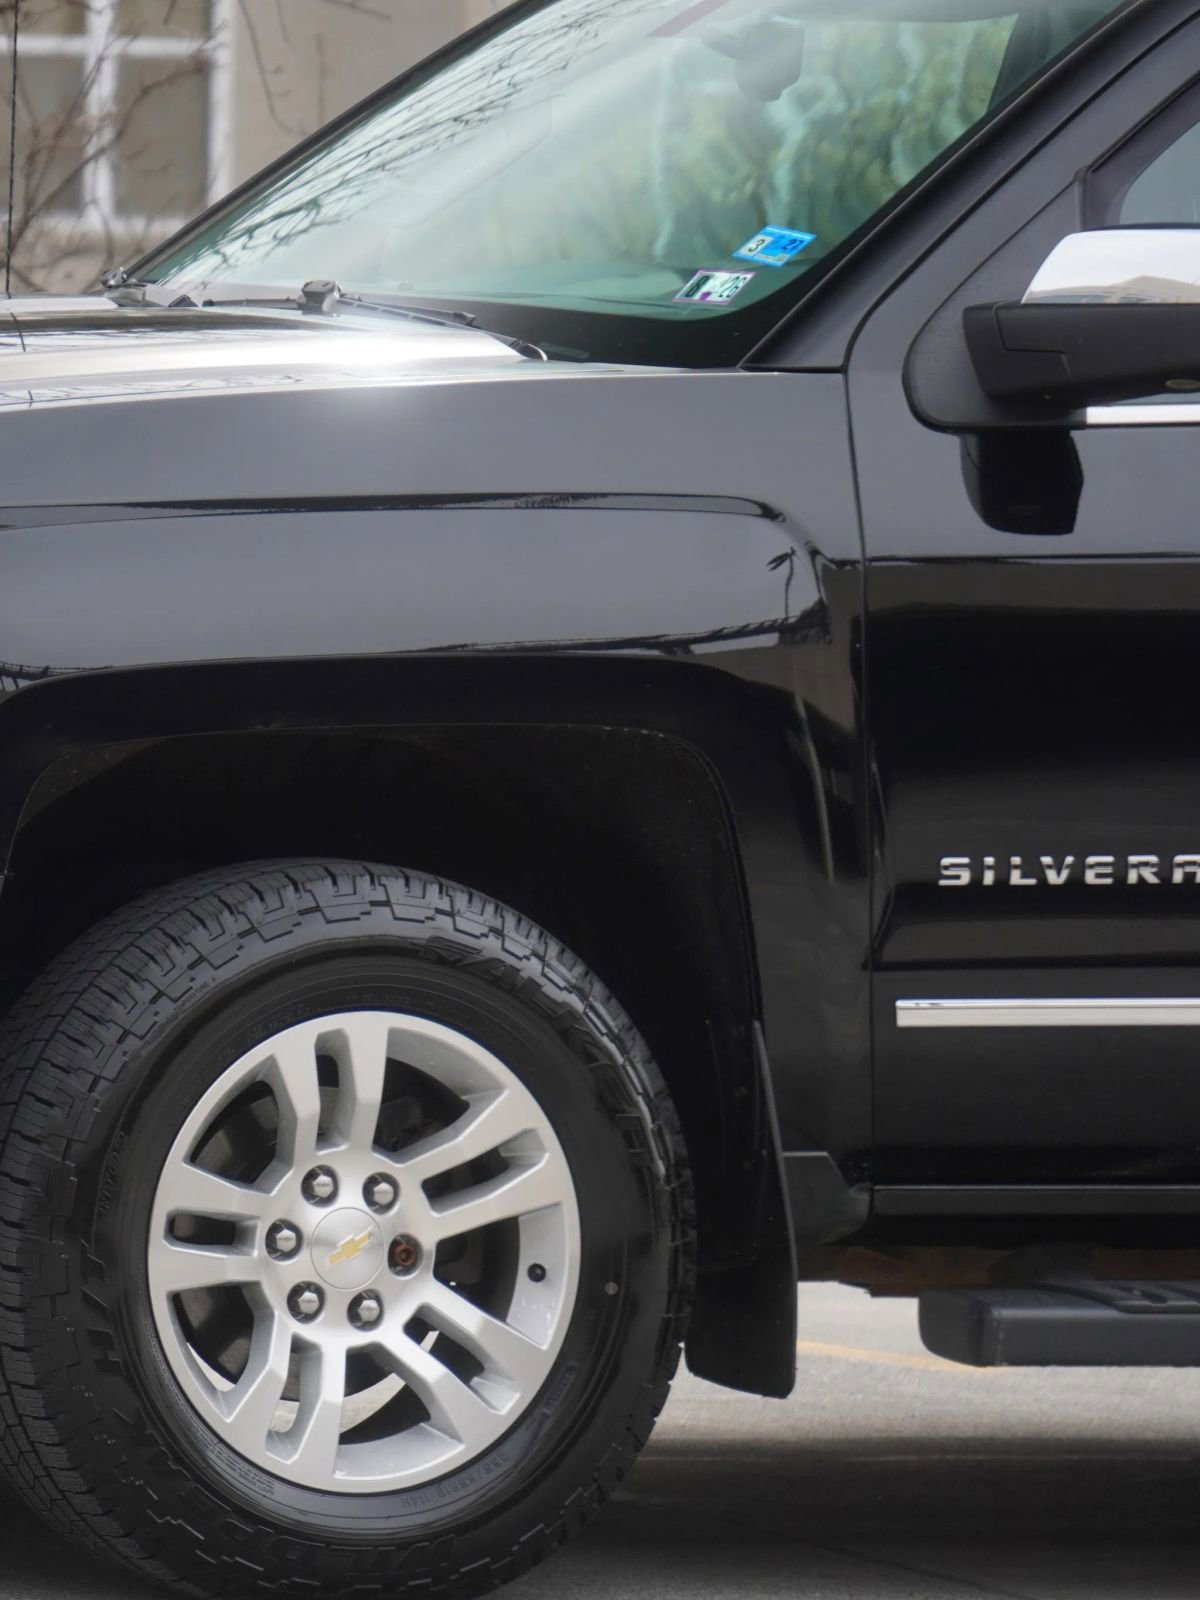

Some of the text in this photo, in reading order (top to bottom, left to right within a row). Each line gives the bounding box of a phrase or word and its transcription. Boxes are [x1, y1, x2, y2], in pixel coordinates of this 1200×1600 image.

[748, 238, 805, 252] 3 27
[718, 275, 748, 299] 26
[938, 854, 1200, 886] SILVERA
